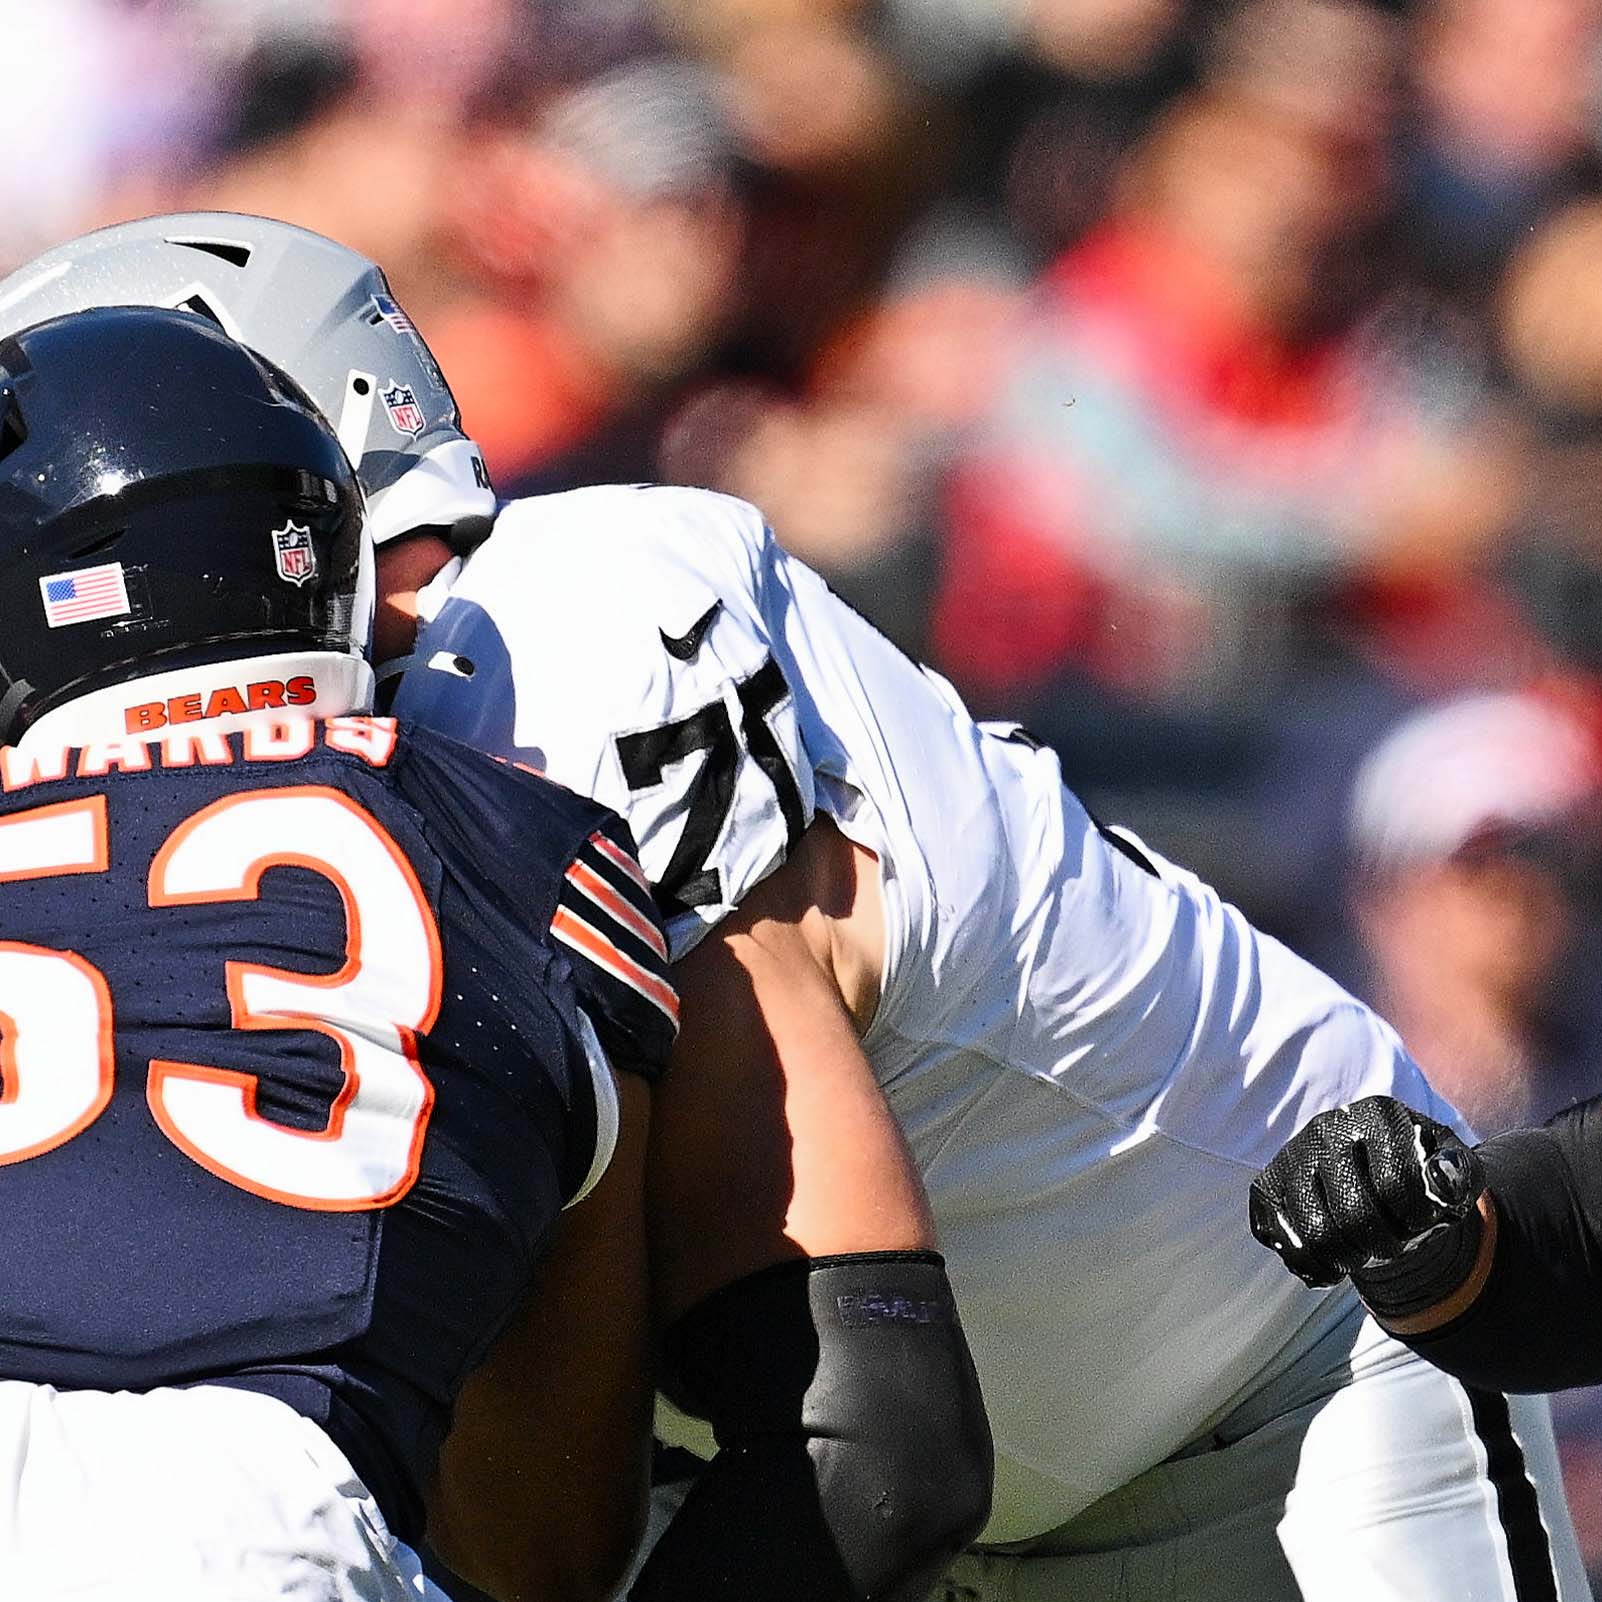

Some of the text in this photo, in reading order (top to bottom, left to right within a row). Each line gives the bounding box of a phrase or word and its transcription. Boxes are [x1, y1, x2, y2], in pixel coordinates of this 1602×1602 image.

[389, 405, 424, 431] NFL
[282, 549, 312, 576] NFL
[124, 676, 318, 735] BEARS
